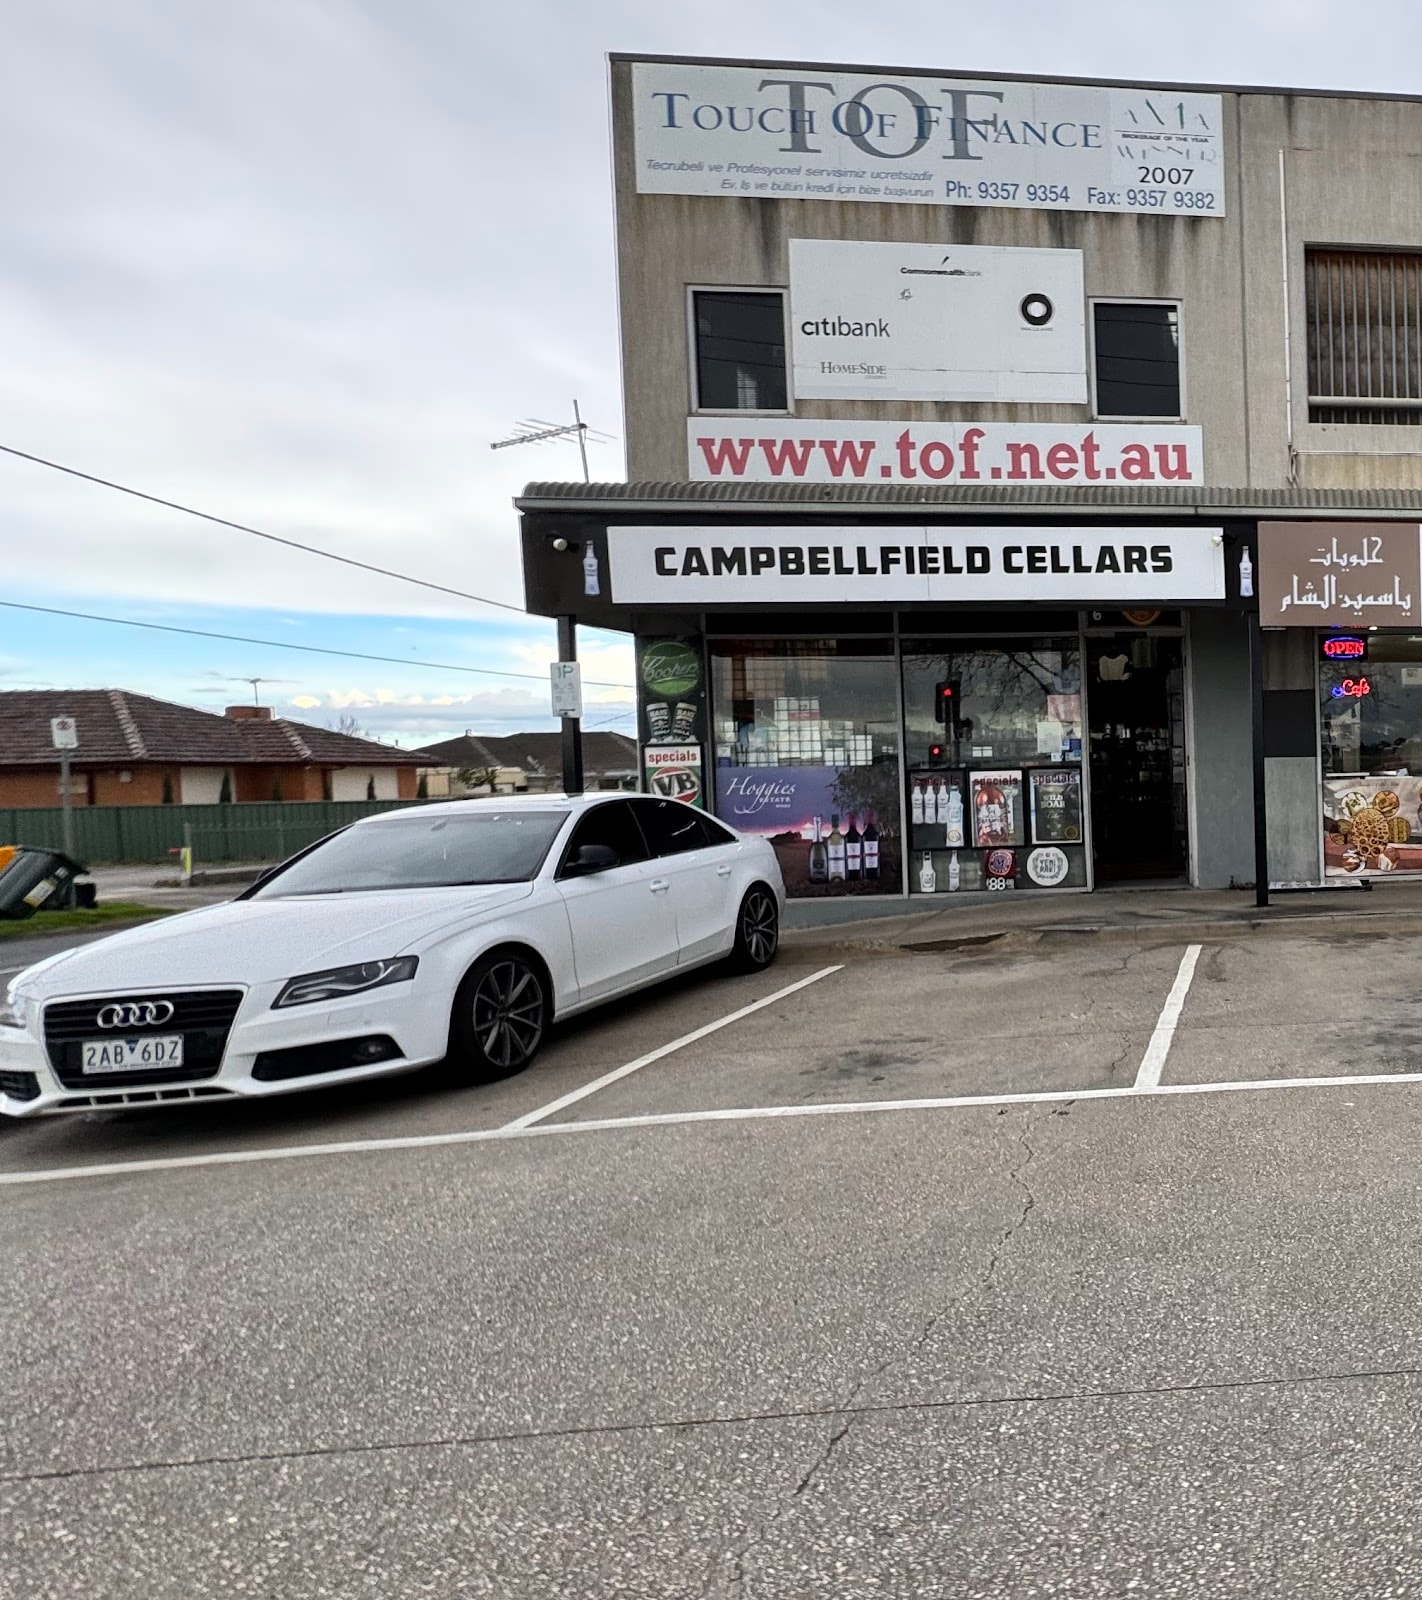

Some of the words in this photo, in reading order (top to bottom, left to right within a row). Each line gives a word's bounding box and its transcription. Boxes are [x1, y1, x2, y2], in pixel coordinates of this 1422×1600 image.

[651, 92, 817, 136] TOUCH
[832, 100, 898, 138] OF
[913, 104, 1102, 149] FINANCE
[757, 79, 1004, 161] TOF
[708, 163, 725, 173] ve
[1137, 166, 1195, 185] 2007
[754, 182, 769, 191] ve
[945, 180, 972, 199] Ph:
[977, 182, 1020, 201] 9357
[1026, 184, 1070, 203] 9354
[1087, 187, 1121, 206] Fax:
[1126, 189, 1167, 207] 9357
[1173, 191, 1216, 210] 9382
[801, 316, 891, 338] citibank
[696, 428, 1193, 480] www.tof.net.au
[653, 544, 991, 577] CAMPBELLFIELD
[1002, 544, 1174, 575] CELLARS
[1324, 641, 1365, 656] OPEN
[648, 750, 698, 765] specials
[652, 771, 697, 798] VB
[725, 775, 797, 814] Hoggies
[86, 1045, 124, 1067] 2AB
[141, 1041, 179, 1063] 6DZ
